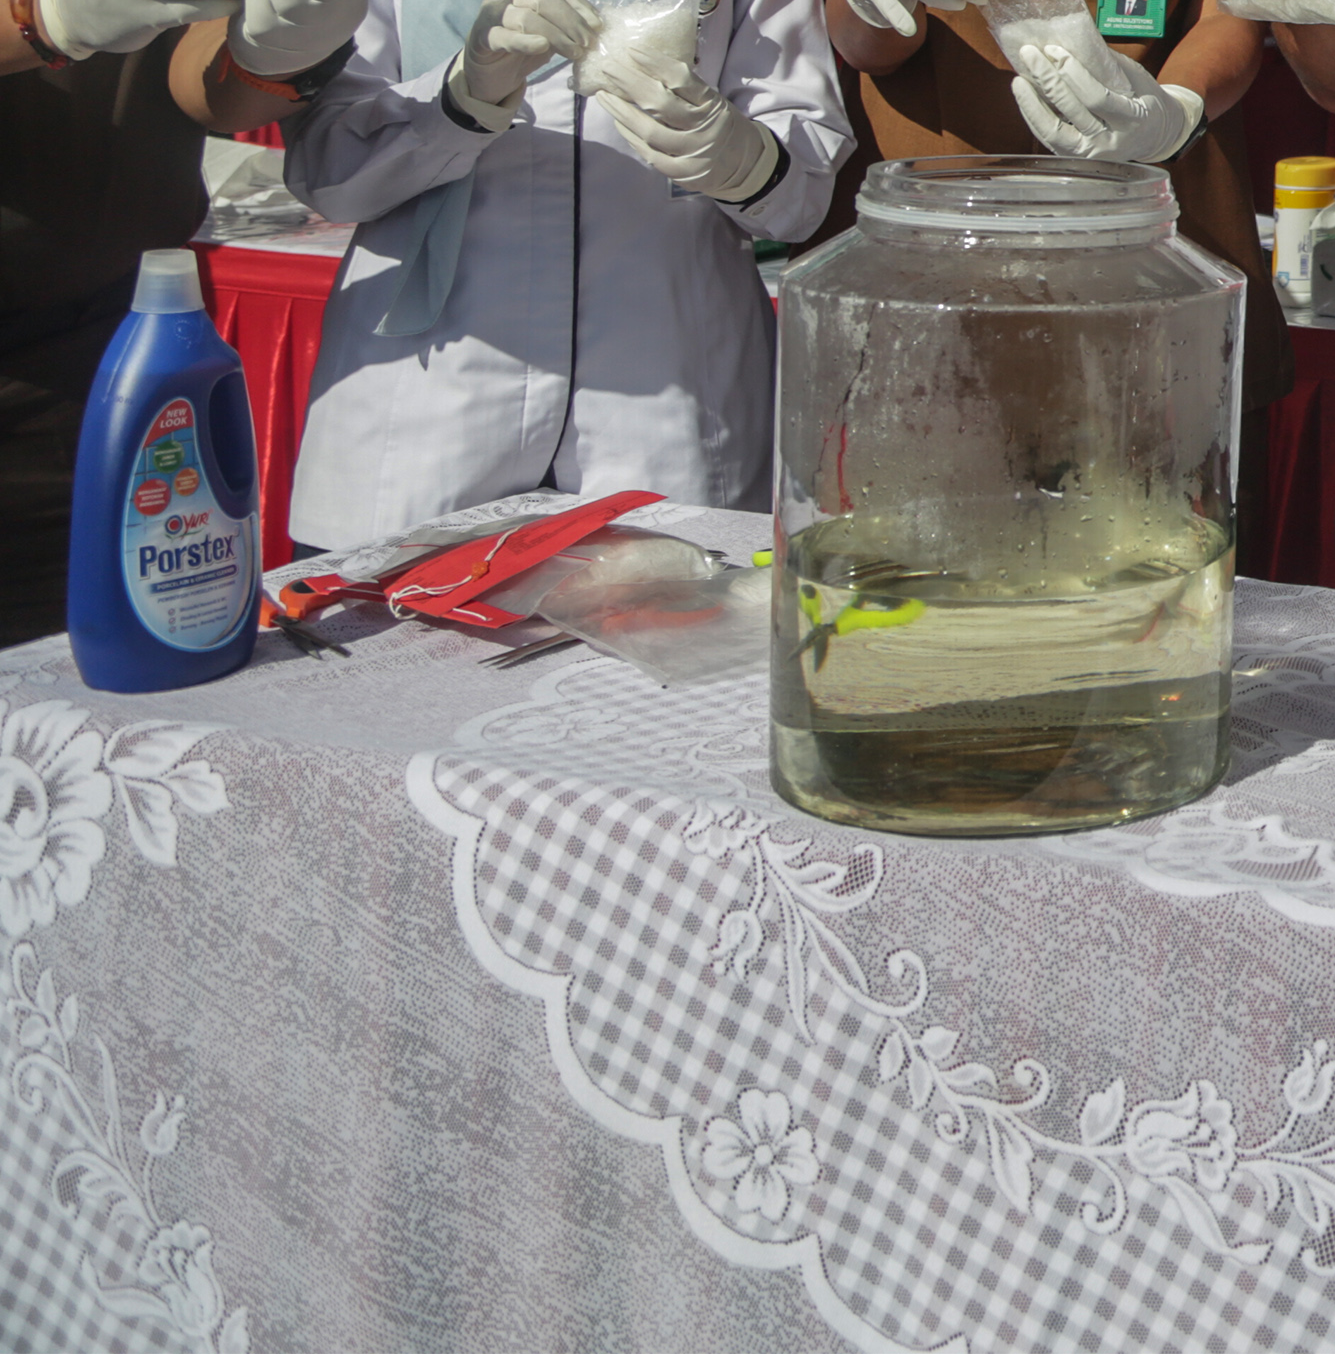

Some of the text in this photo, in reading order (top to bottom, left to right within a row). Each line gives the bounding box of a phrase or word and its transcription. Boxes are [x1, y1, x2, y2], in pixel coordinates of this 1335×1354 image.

[166, 407, 188, 418] NEW
[160, 416, 187, 429] LOOK
[139, 533, 235, 577] Porstex
[157, 579, 190, 591] PORCELAIN
